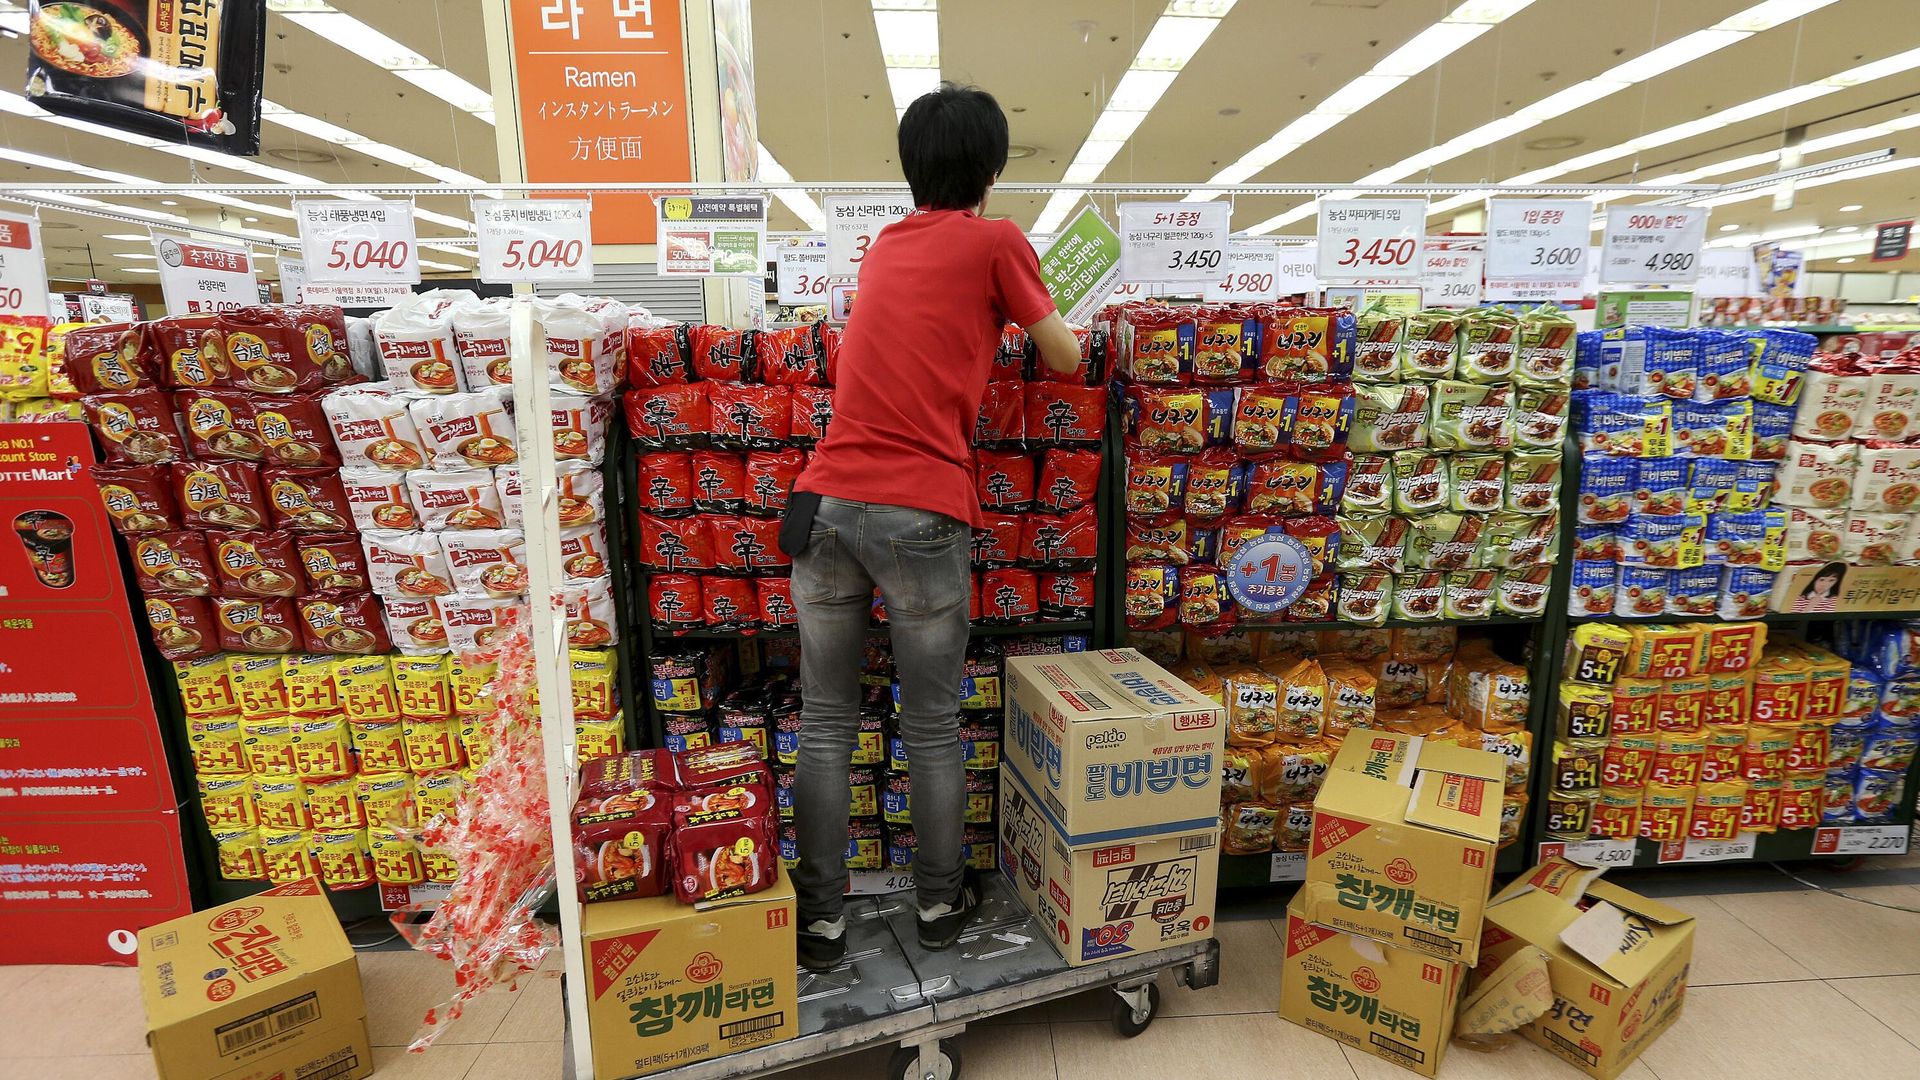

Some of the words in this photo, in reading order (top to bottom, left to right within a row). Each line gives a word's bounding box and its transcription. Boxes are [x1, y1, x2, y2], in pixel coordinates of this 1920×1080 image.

[564, 66, 636, 87] Ramen
[538, 100, 674, 121] インスタントラーメン
[569, 136, 642, 161] 方便面
[329, 208, 370, 222] 태풍냉면
[370, 209, 386, 222] 4입
[502, 209, 519, 222] 둥지
[520, 209, 552, 222] 비빔냉면
[835, 205, 855, 217] 농심
[856, 205, 886, 217] 신라면
[1153, 211, 1174, 225] 5+1
[1175, 211, 1201, 226] 증정
[1328, 209, 1347, 221] 농심
[1348, 209, 1385, 221] 짜파게티
[1523, 210, 1541, 224] 1입
[1541, 210, 1565, 224] 증정
[1128, 232, 1142, 241] 농심
[1143, 232, 1162, 241] 너구리
[1163, 232, 1189, 241] 얼큰한맛
[189, 248, 238, 270] 추천상품
[327, 240, 408, 272] 5,040
[502, 239, 583, 271] 5,040
[1055, 236, 1105, 283] 박스라면이
[1168, 249, 1221, 271] 3,450
[1338, 238, 1417, 268] 3,450
[1530, 247, 1581, 266] 3,600
[1645, 252, 1694, 271] 4,980
[197, 279, 228, 292] 삼양라면
[1063, 253, 1109, 301] 우리집까지!
[1219, 273, 1273, 294] 4,980
[1440, 283, 1476, 297] 3,040
[1140, 340, 1175, 354] 너구리
[1277, 331, 1323, 350] 너구리
[1468, 341, 1517, 356] 짜파게티
[1044, 398, 1078, 444] 辛
[1375, 410, 1428, 429] 짜파게티
[11, 439, 34, 449] NO.1
[28, 452, 57, 462] Store
[1133, 474, 1168, 489] 너구리
[1265, 474, 1313, 491] 너구리
[1457, 477, 1504, 492] 짜파게티
[732, 529, 764, 571] 辛
[1034, 525, 1064, 563] 辛
[1247, 584, 1286, 596] 추가증정
[1399, 586, 1444, 599] 짜파게티
[1500, 580, 1551, 595] 짜파게티
[658, 591, 684, 624] 辛
[186, 674, 235, 708] 5+1
[291, 674, 338, 707] 5+1
[979, 678, 997, 695] +1
[351, 683, 394, 715] 5+1
[1287, 694, 1321, 707] 너구리
[1757, 692, 1799, 719] 5+1
[1180, 713, 1211, 727] 행사용
[1572, 711, 1608, 735] 5+1
[863, 733, 880, 751] +1
[1086, 728, 1127, 749] paldo
[298, 741, 341, 773] 5+1
[411, 732, 452, 765] 5+1
[1109, 752, 1213, 798] 비빔면
[1285, 764, 1326, 781] 너구리
[1604, 759, 1646, 785] 5+1
[1691, 814, 1735, 837] 5+1
[1868, 836, 1905, 849] 2,270
[1594, 849, 1631, 862] 4,500
[376, 851, 418, 880] 5+1
[1102, 864, 1191, 904] 짜파게티
[386, 893, 407, 904] 추천
[1335, 873, 1460, 934] 참깨라면
[692, 965, 717, 979] 오뚜기
[629, 981, 774, 1038] 참깨라면
[1307, 975, 1421, 1042] 참깨라면
